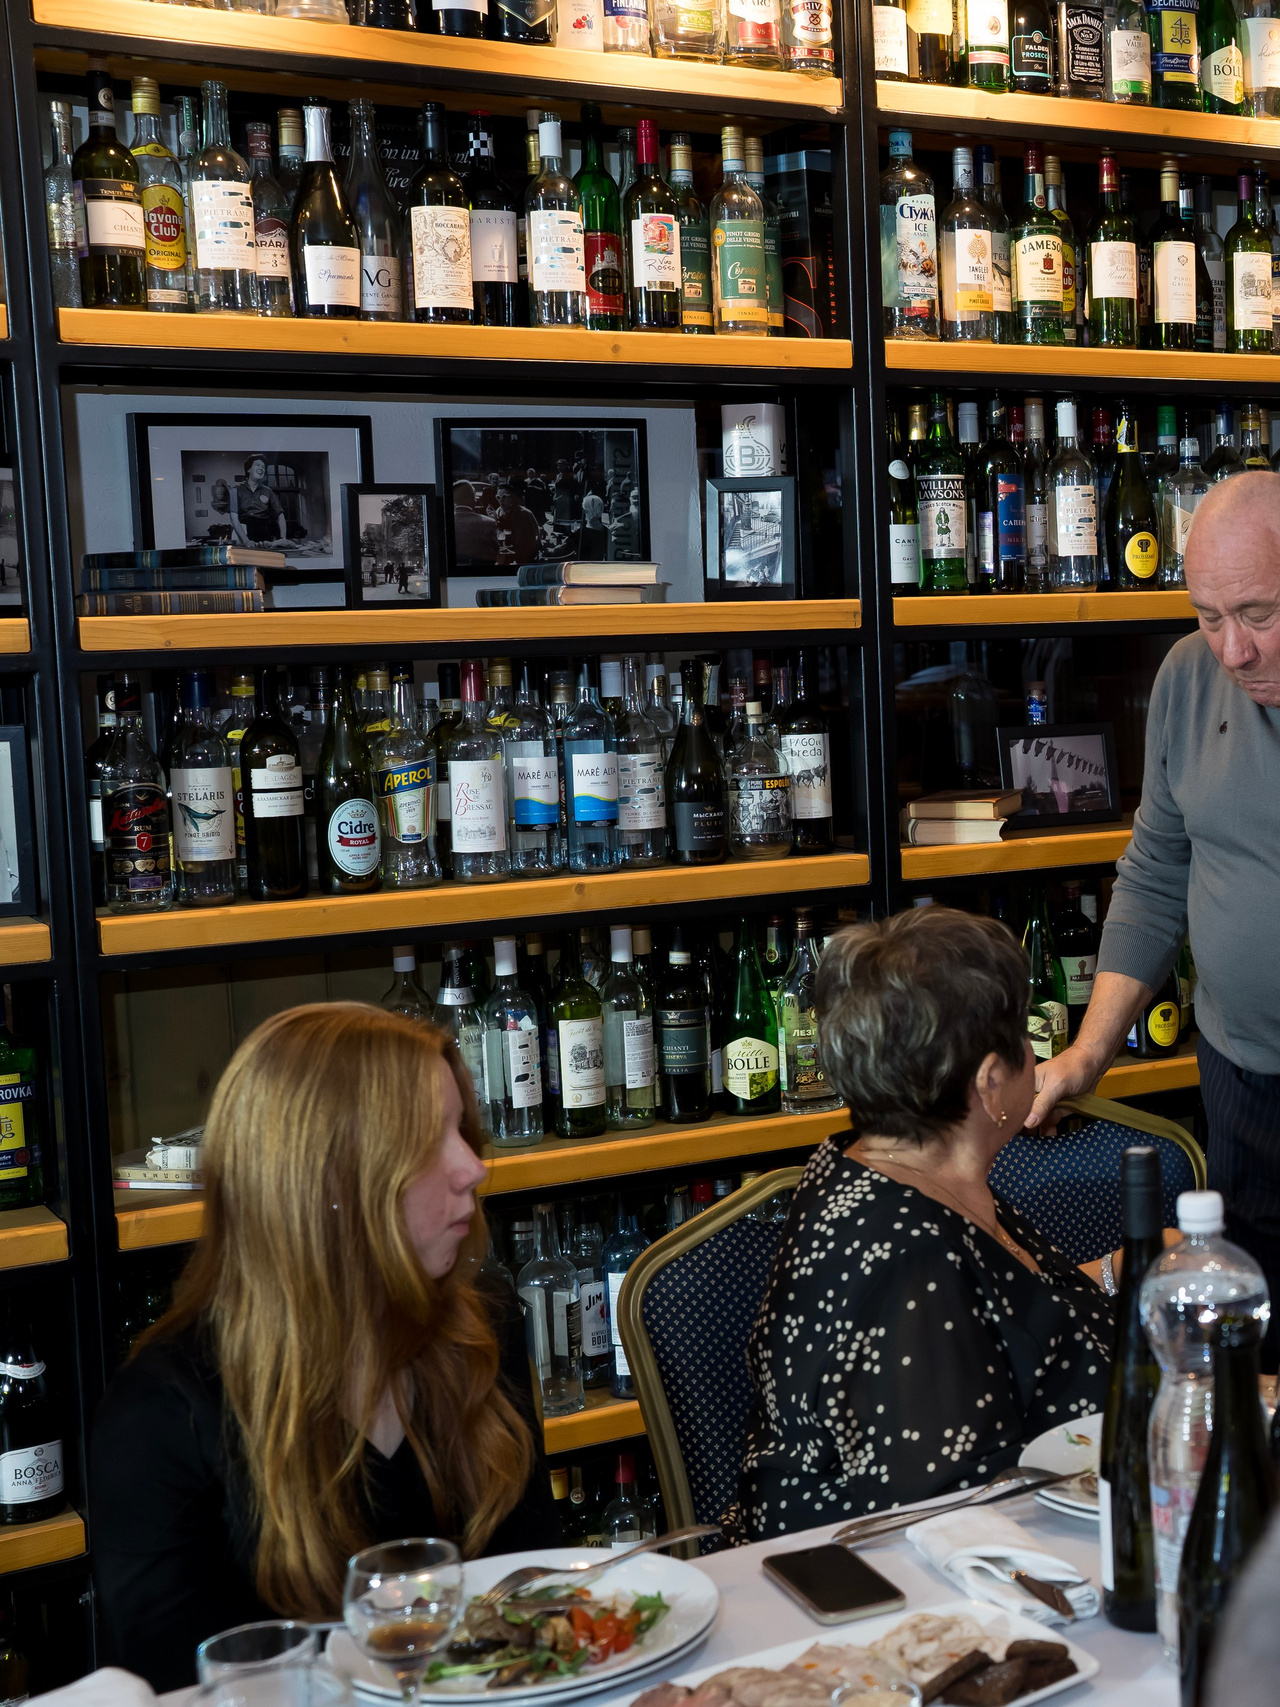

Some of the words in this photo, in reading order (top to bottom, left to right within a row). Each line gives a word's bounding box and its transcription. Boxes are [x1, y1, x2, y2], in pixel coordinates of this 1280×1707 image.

[1067, 16, 1081, 29] JACK
[823, 50, 830, 58] 12
[260, 141, 266, 150] 3
[899, 203, 934, 223] СТУЖА
[151, 223, 178, 237] Club
[914, 222, 928, 233] ICE
[149, 249, 182, 259] ORIGINAL
[272, 260, 278, 268] 3
[644, 259, 676, 274] Rosso
[969, 266, 989, 274] TANGLED
[362, 268, 392, 288] VG
[973, 274, 986, 282] TREE
[920, 481, 962, 490] WILLIAM
[919, 490, 965, 500] LAWSON'S
[790, 737, 815, 747] PAGO
[790, 747, 822, 757] breda
[518, 768, 541, 780] MARÉ
[544, 770, 557, 779] ALTA
[577, 767, 600, 777] MARÉ
[603, 767, 616, 776] ALTA
[384, 768, 432, 792] APEROL
[177, 791, 225, 802] STELARIS
[455, 799, 494, 817] BRESSAC
[337, 821, 375, 835] Cidre
[141, 836, 148, 848] 7
[727, 1056, 770, 1071] BOLLE
[585, 1292, 603, 1311] JIM
[14, 1459, 60, 1480] BOSCA
[35, 1470, 62, 1484] FEDERICA
